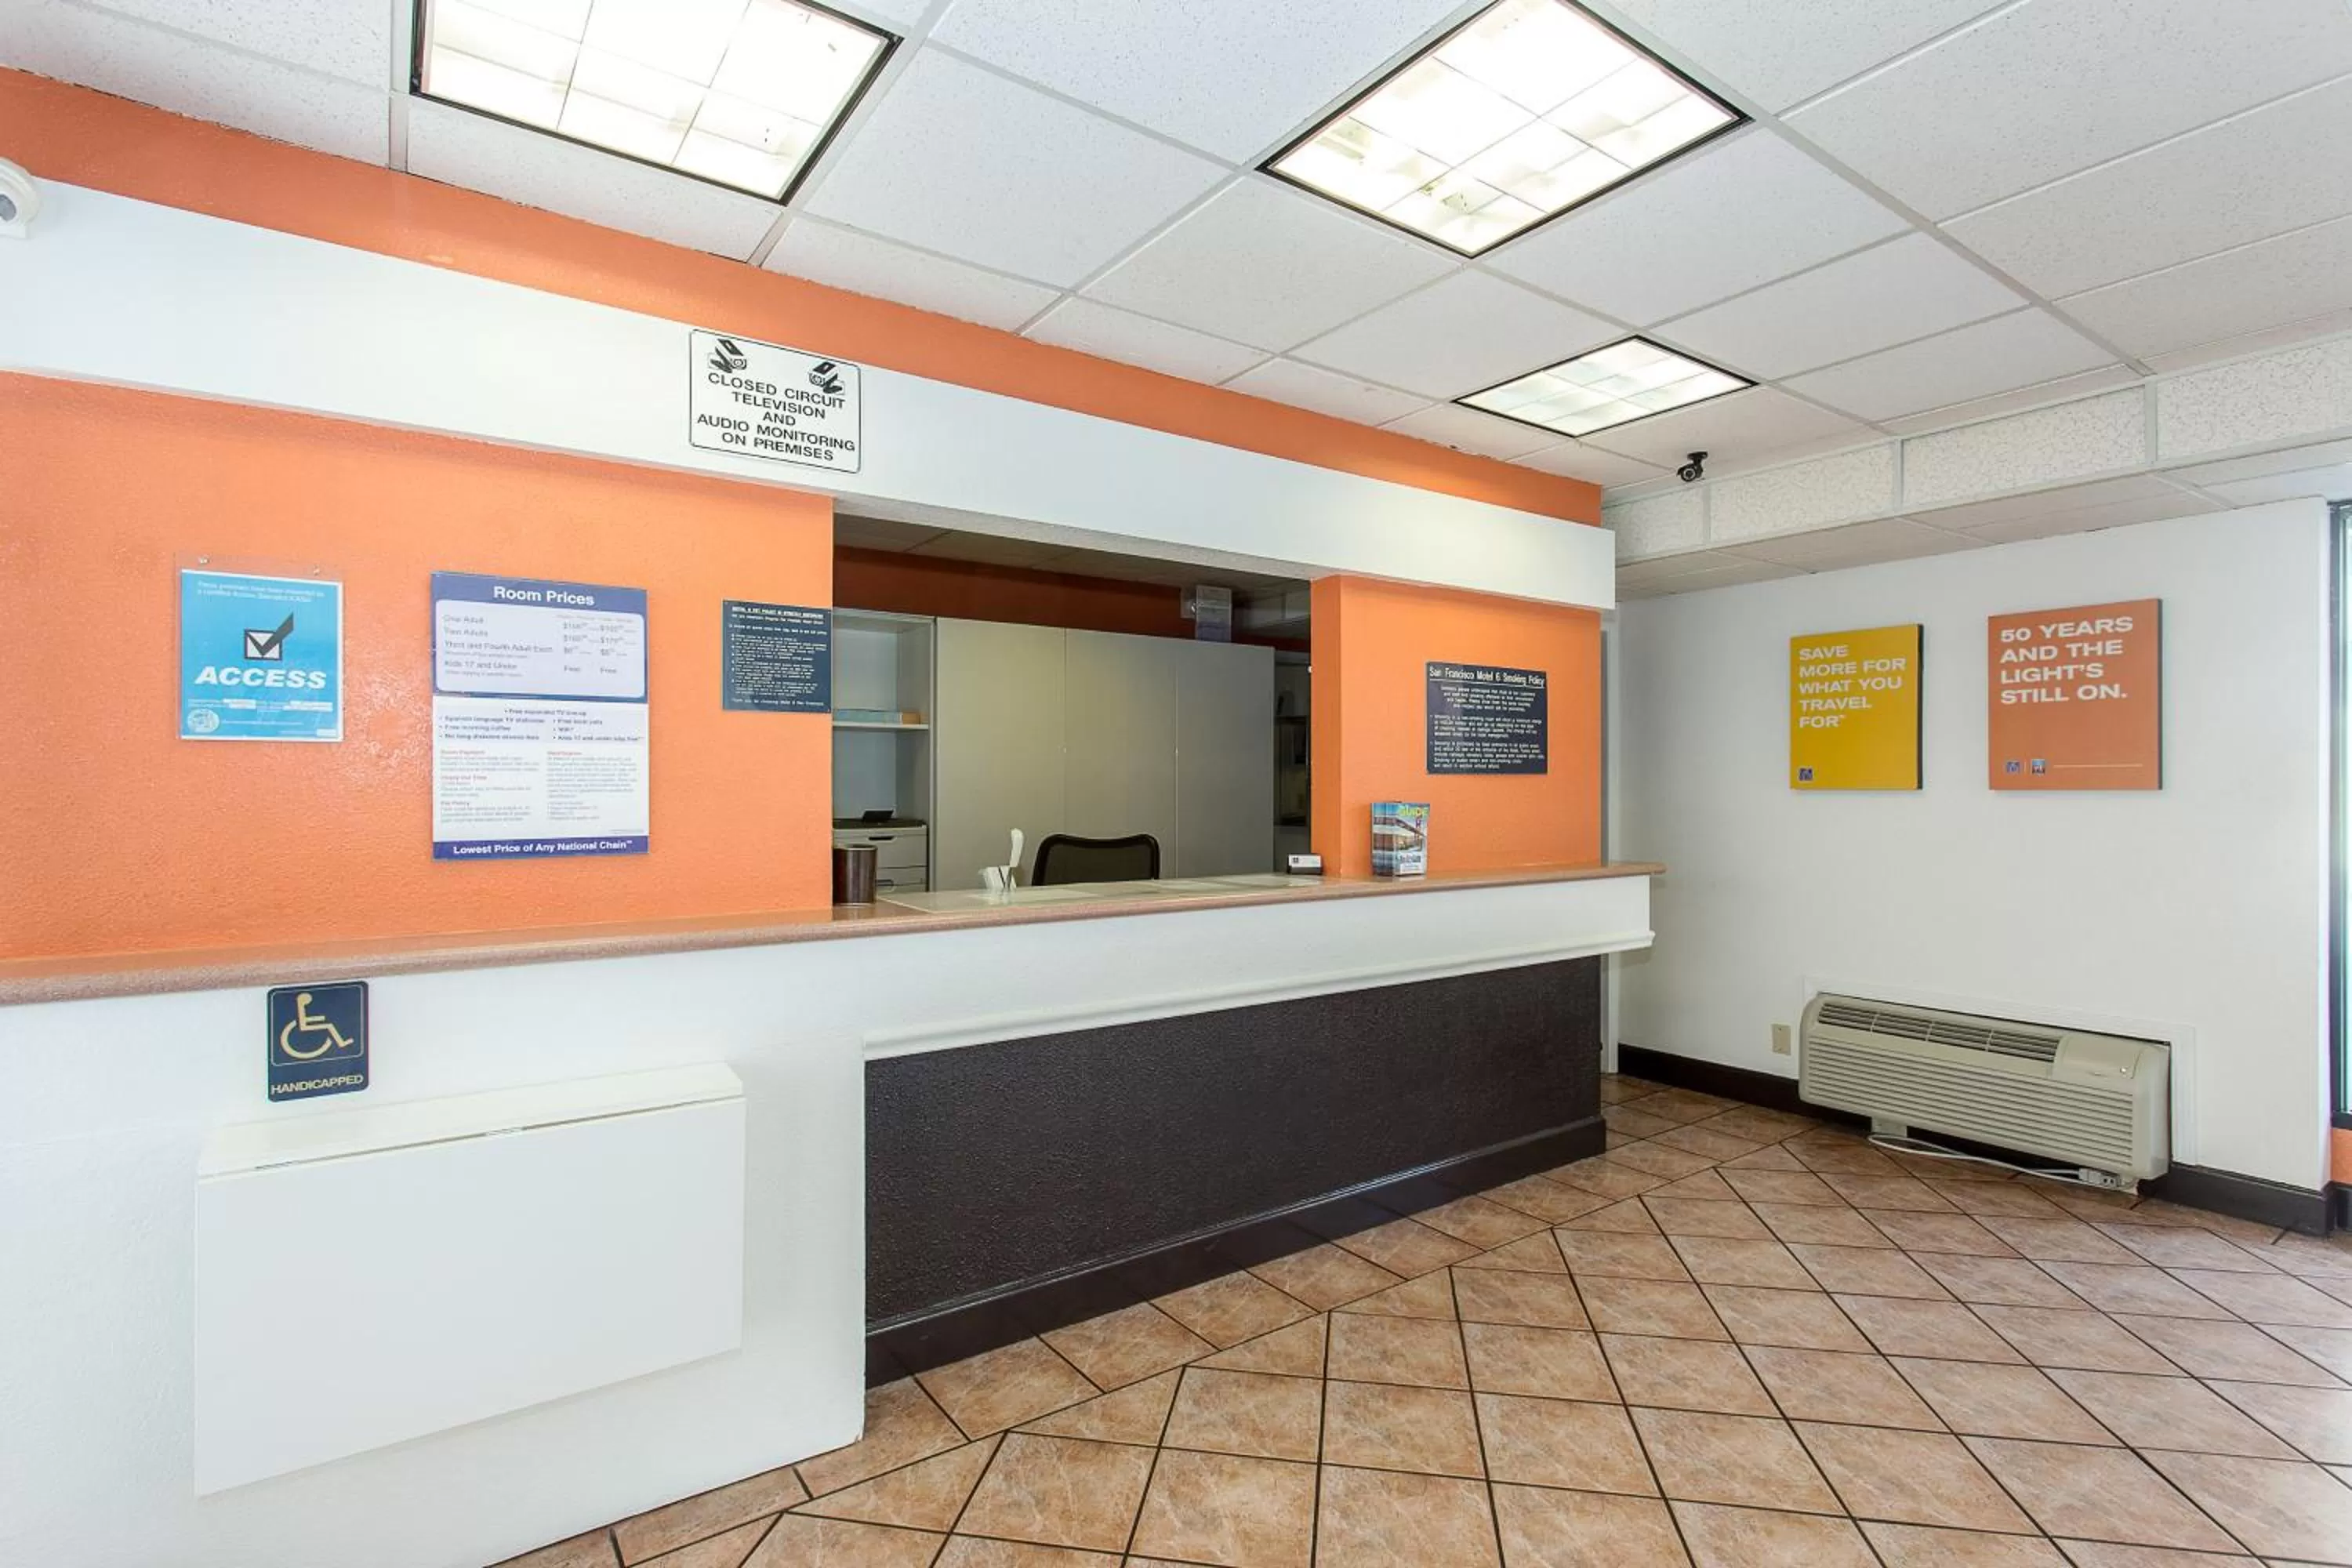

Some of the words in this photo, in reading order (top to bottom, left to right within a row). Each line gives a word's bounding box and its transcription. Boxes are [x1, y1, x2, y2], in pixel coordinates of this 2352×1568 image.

[708, 372, 777, 395] CLOSED
[784, 388, 845, 408] CIRCUIT
[731, 391, 826, 419] TELEVISION
[763, 412, 796, 426] AND
[697, 413, 750, 432] AUDIO
[757, 424, 855, 451] MONITORING
[721, 433, 746, 446] ON
[753, 437, 833, 461] PREMISES
[493, 586, 542, 602] Room
[546, 590, 595, 606] Prices
[2000, 629, 2031, 643] 50
[2038, 617, 2133, 639] YEARS
[1798, 644, 1849, 661] SAVE
[2000, 646, 2058, 663] AND
[2066, 640, 2123, 657] THE
[194, 666, 327, 689] ACCESS
[1430, 666, 1442, 677] San
[1445, 667, 1474, 679] Francisco
[1477, 670, 1494, 681] Motel
[1503, 672, 1526, 686] Smoking
[1528, 675, 1545, 688] Policy
[1798, 662, 1857, 678] MORE
[1863, 658, 1907, 673] FOR
[2000, 663, 2104, 684] LIGHT'S
[1798, 680, 1852, 695] WHAT
[1859, 677, 1902, 690] YOU
[2000, 689, 2068, 705] STILL
[2077, 684, 2127, 700] ON.
[1799, 696, 1872, 712] TRAVEL
[453, 844, 492, 855] Lowest
[494, 844, 521, 854] Price
[523, 844, 534, 852] of
[535, 843, 555, 853] Any
[557, 841, 597, 851] National
[270, 1074, 365, 1094] HANDICAPPED
